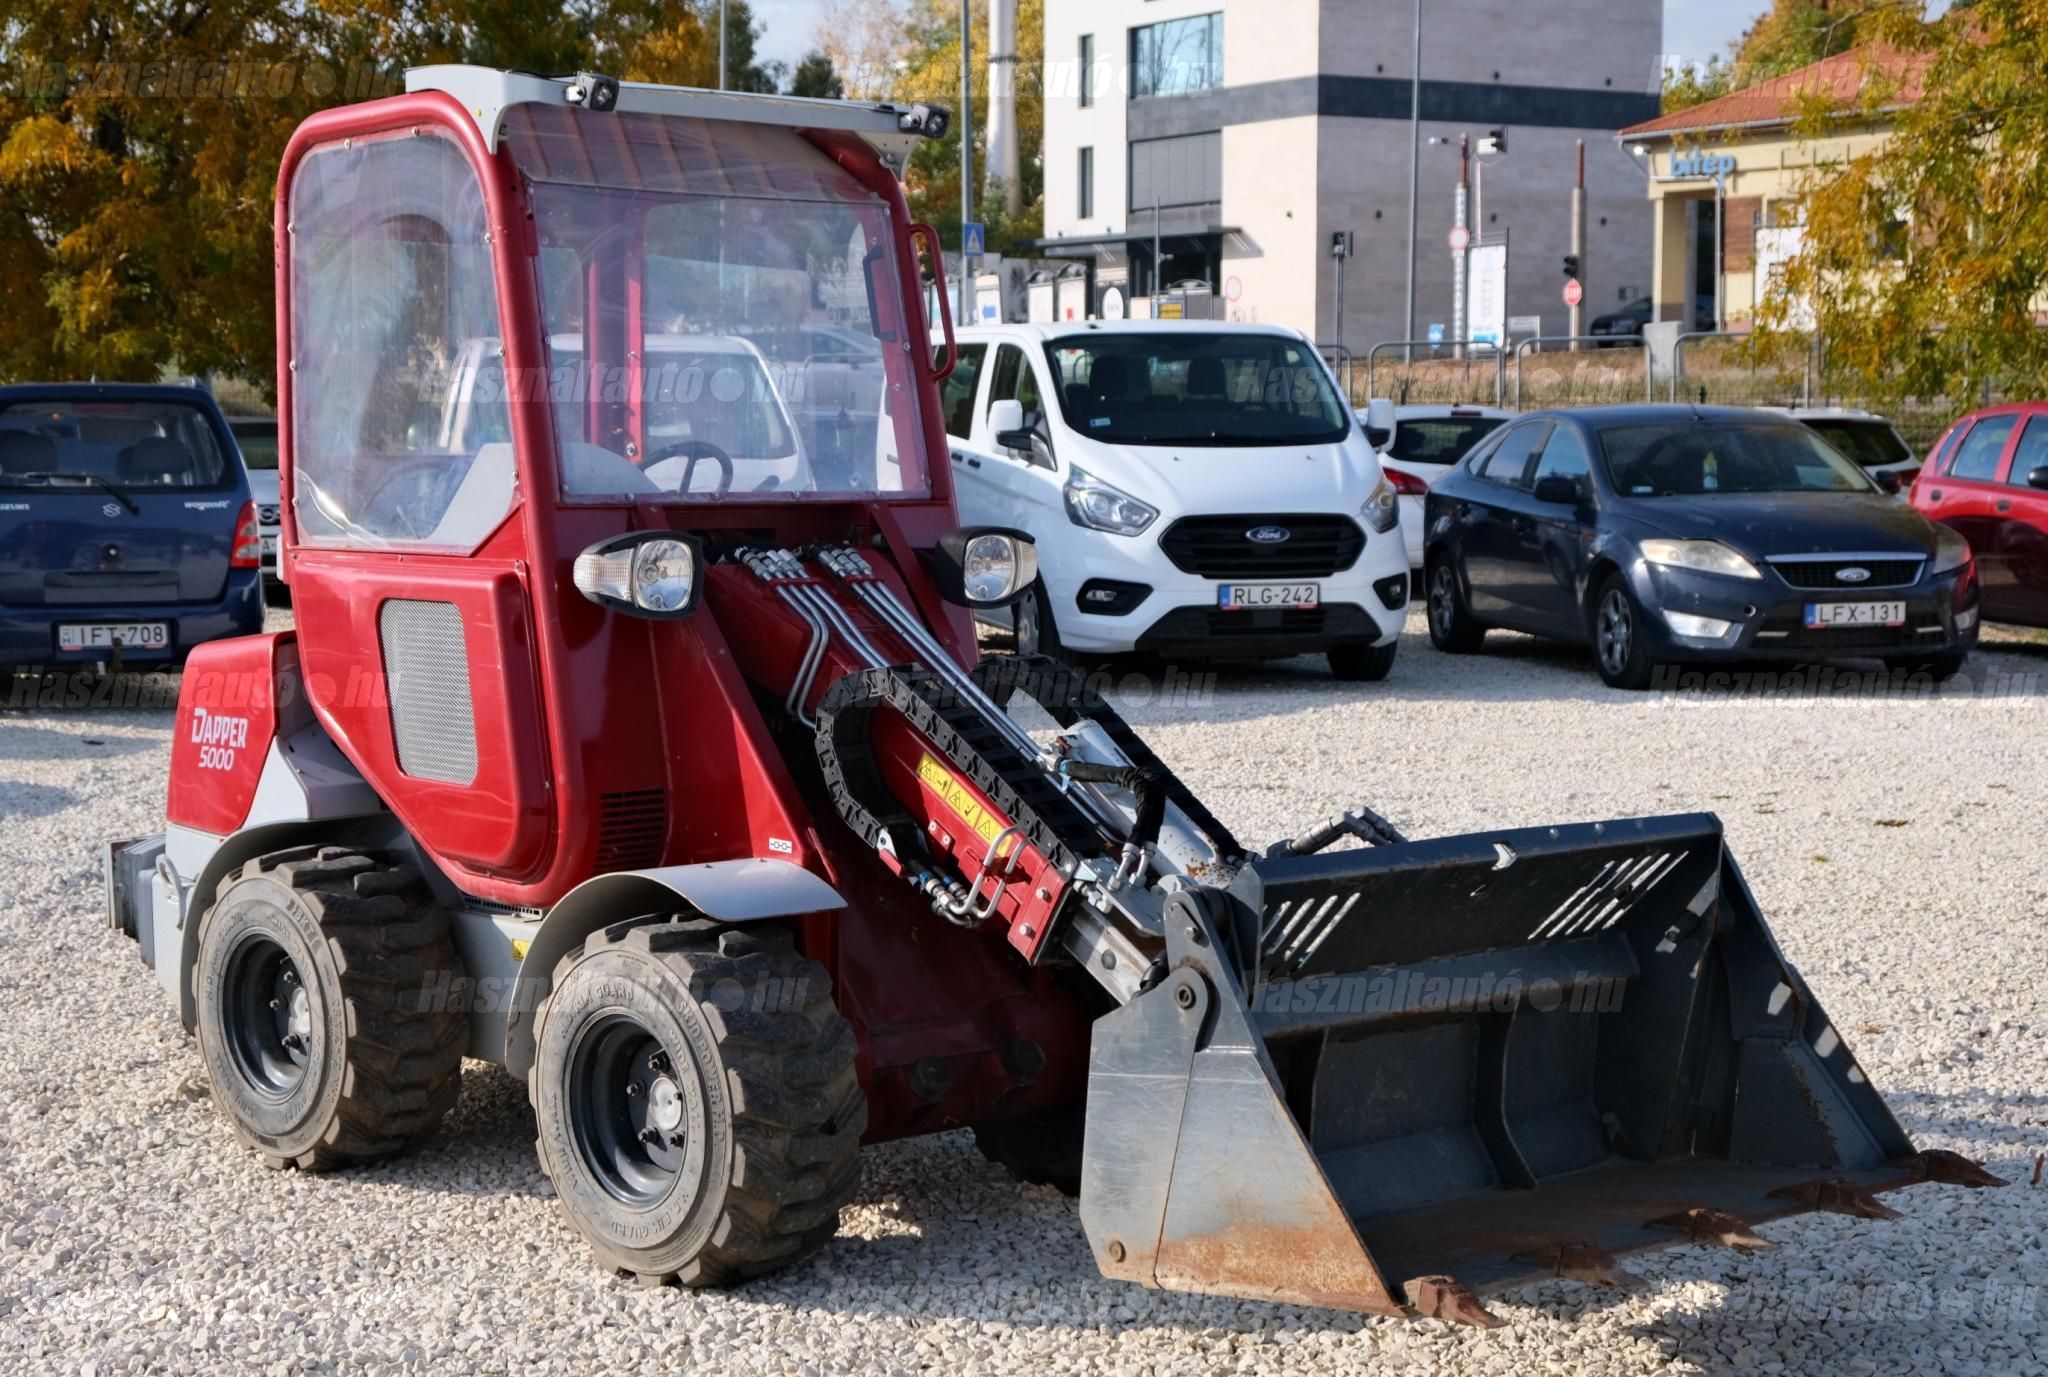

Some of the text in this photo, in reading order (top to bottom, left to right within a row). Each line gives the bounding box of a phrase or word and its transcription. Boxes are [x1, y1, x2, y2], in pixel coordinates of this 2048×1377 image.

[1257, 527, 1281, 540] Ford
[1234, 587, 1314, 605] RLG-242
[1820, 604, 1900, 622] LFX-131
[80, 626, 164, 645] IFT-708
[191, 707, 249, 749] DAPPER
[198, 745, 235, 771] 5000
